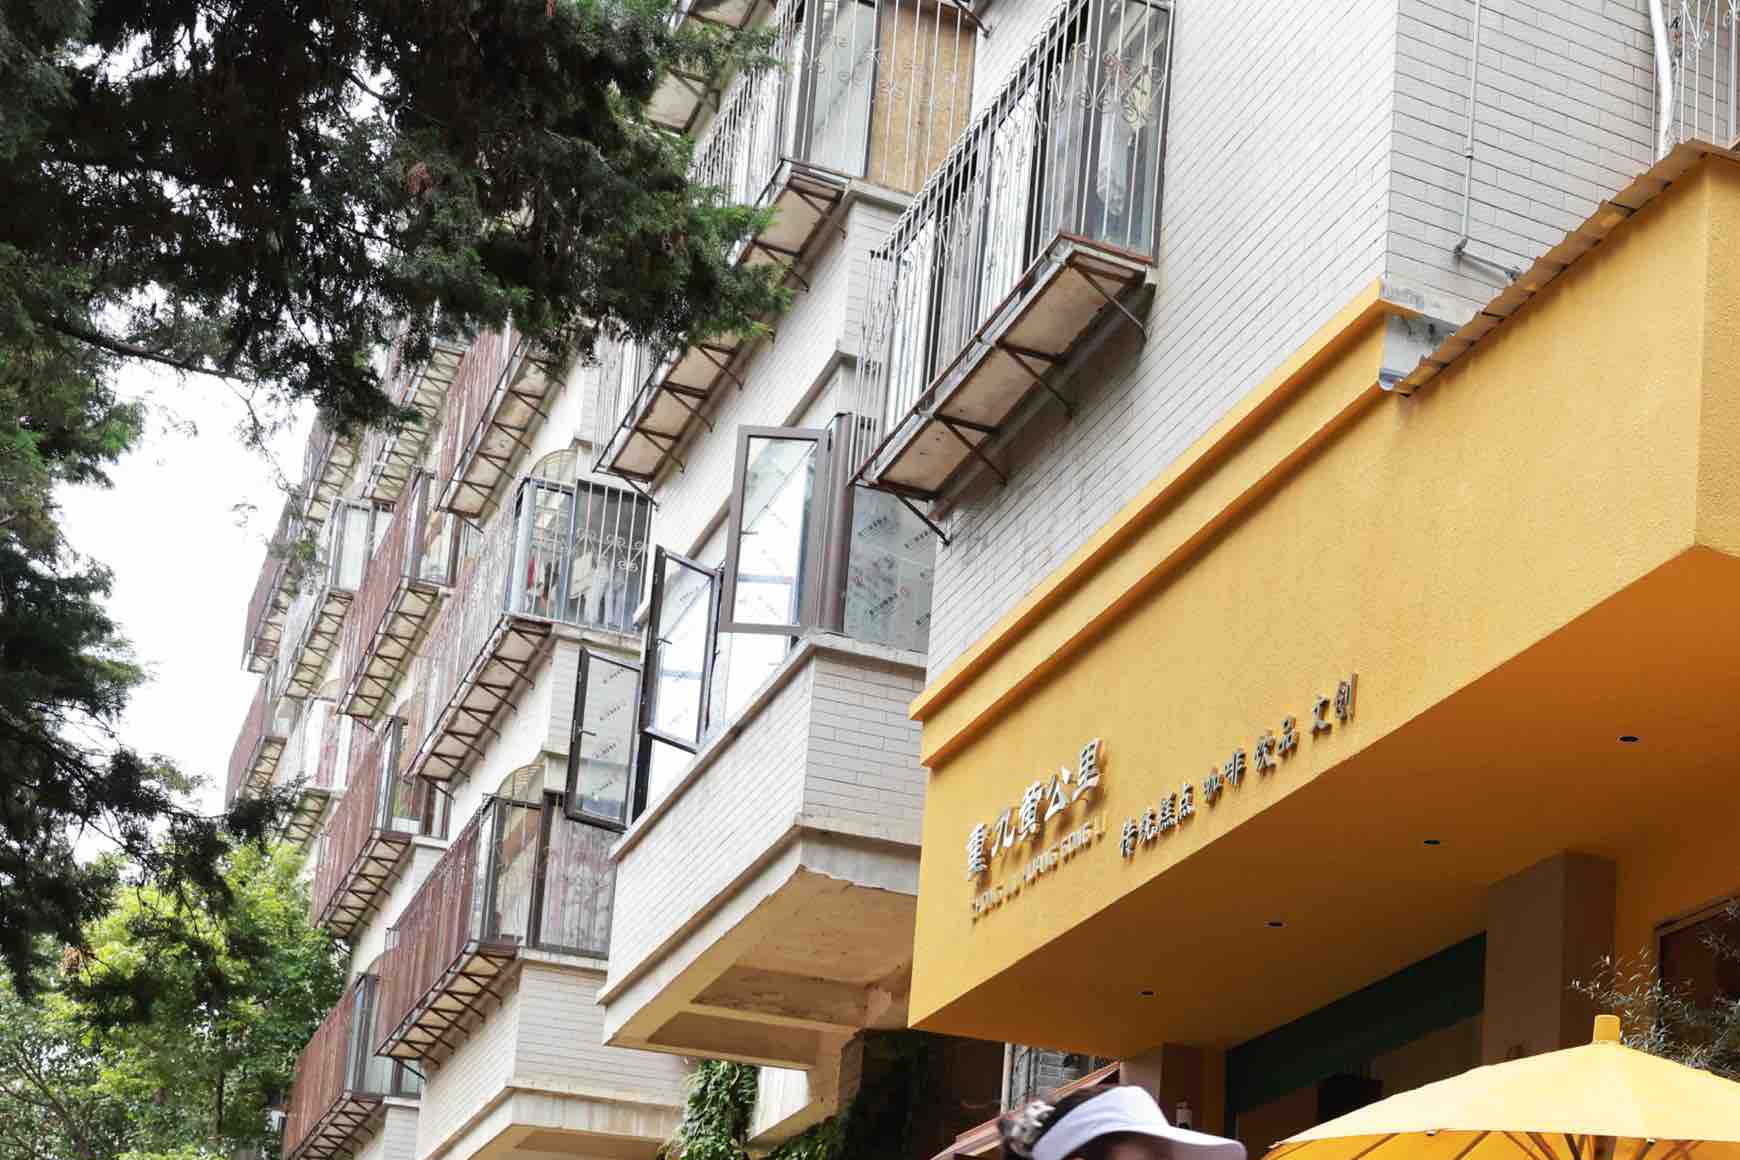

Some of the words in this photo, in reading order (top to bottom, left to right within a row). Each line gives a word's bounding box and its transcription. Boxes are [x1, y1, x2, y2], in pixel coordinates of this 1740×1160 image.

[1202, 749, 1247, 803] 咖啡
[1255, 715, 1299, 773] 饮品
[1312, 673, 1358, 735] 文创
